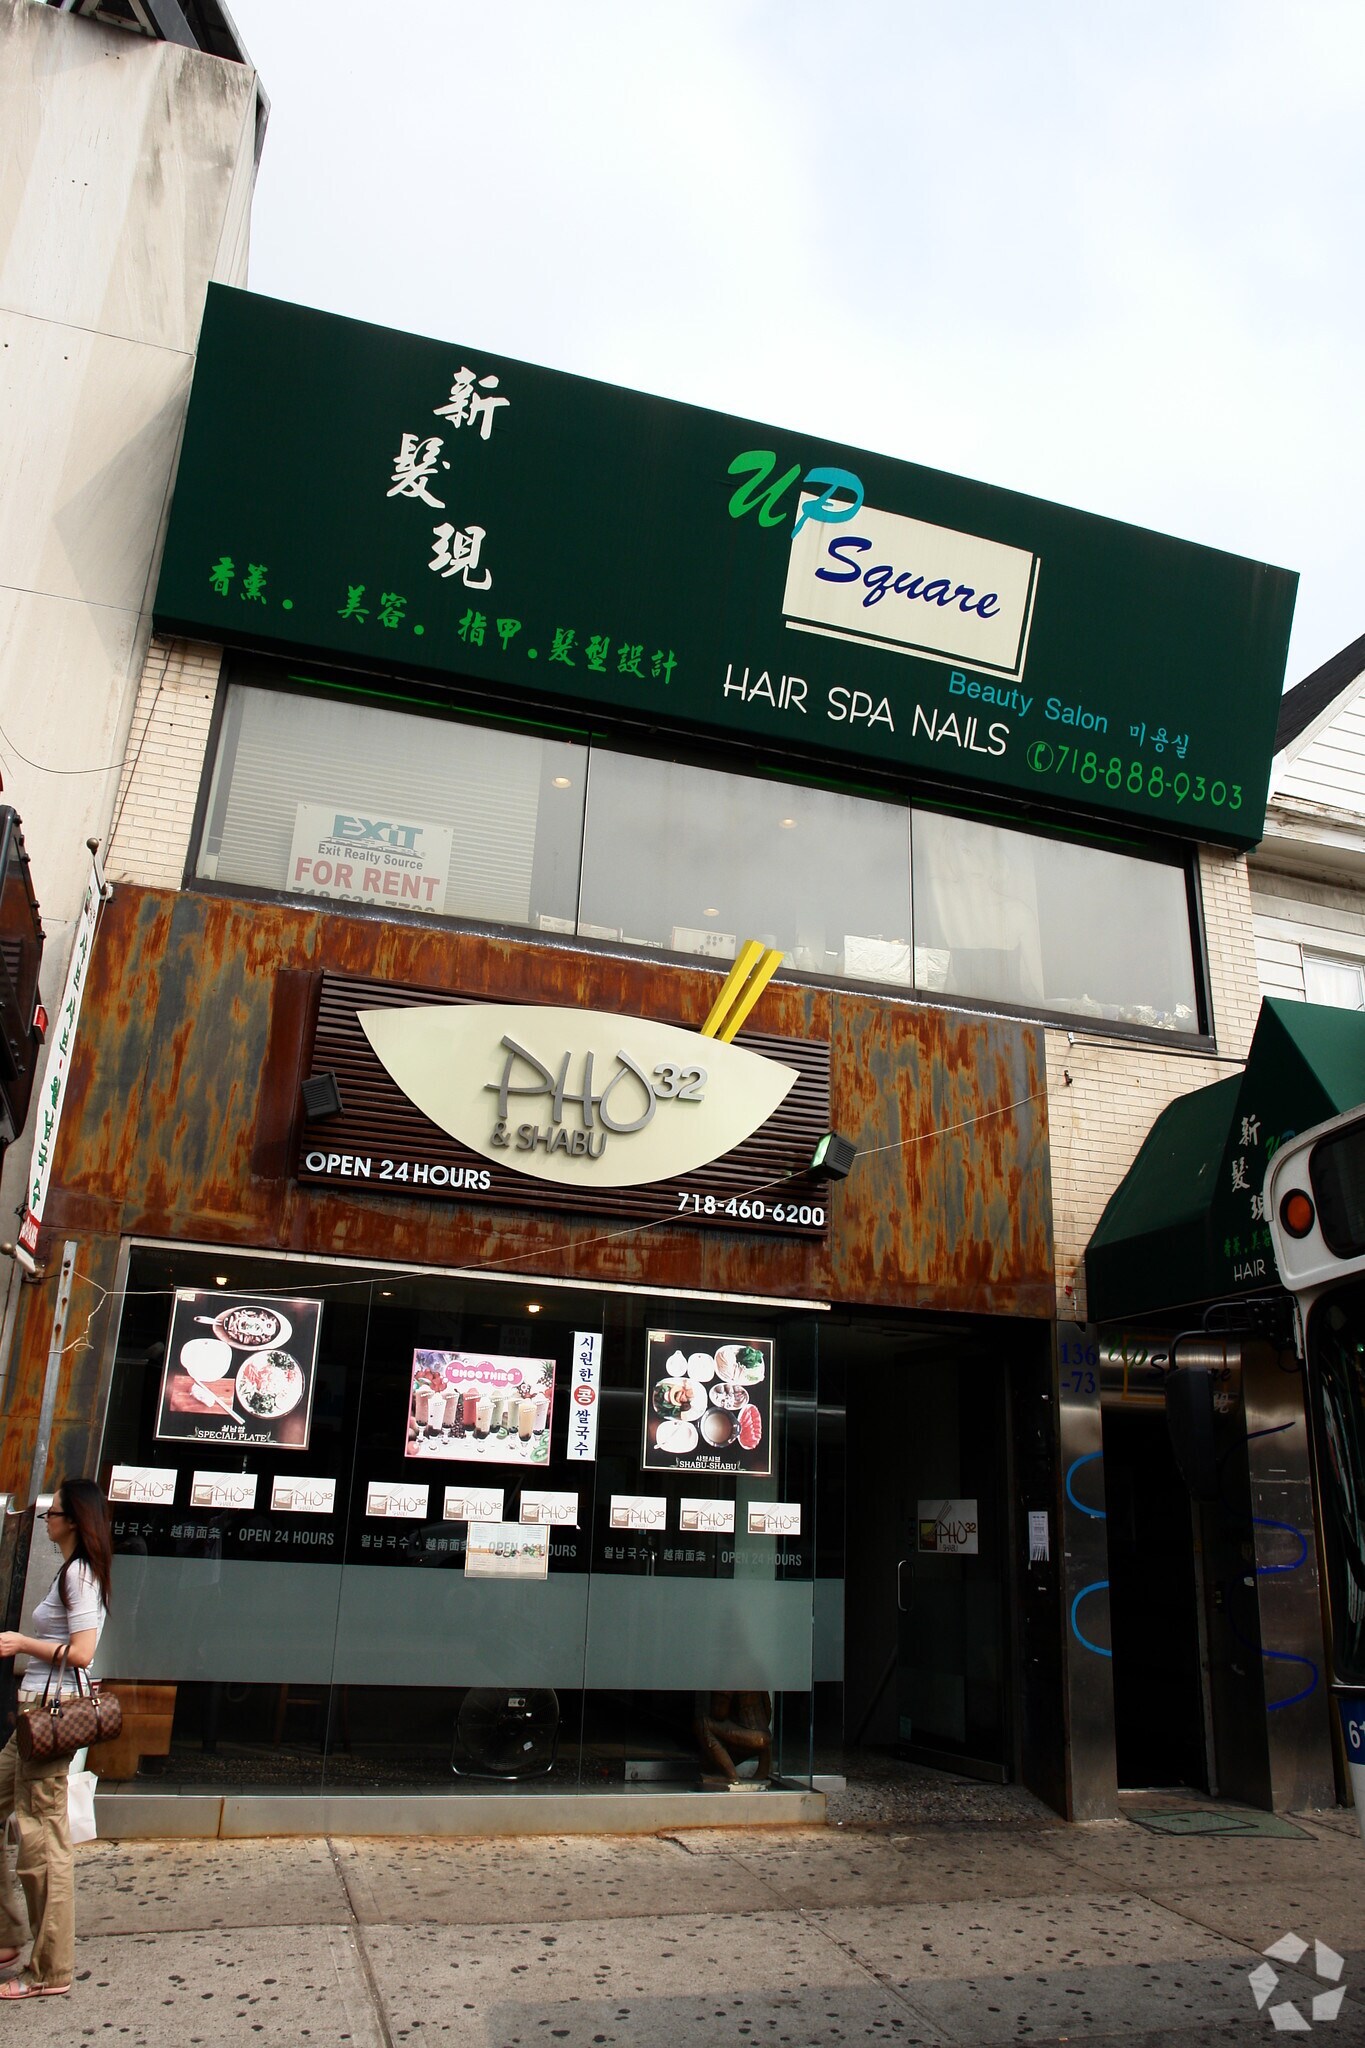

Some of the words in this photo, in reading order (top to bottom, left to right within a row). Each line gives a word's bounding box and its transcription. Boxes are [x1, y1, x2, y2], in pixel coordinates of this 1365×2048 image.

[814, 536, 1000, 620] Square
[723, 663, 808, 714] HAIR
[827, 686, 894, 732] SPA
[912, 704, 1010, 757] NAILS
[949, 671, 1033, 717] Beauty
[1045, 698, 1108, 733] Salon
[1130, 722, 1189, 759] 미용실
[1055, 744, 1242, 810] 718-888-9303
[317, 843, 340, 857] Exit
[344, 847, 381, 865] Realty
[384, 854, 424, 870] Source
[294, 856, 354, 889] FOR
[362, 867, 441, 902] RENT
[484, 1034, 657, 1132] PHO
[653, 1063, 708, 1102] 32
[488, 1119, 512, 1147] &
[518, 1123, 607, 1158] SHABU
[305, 1150, 372, 1178] OPEN
[379, 1158, 409, 1182] 24
[412, 1163, 491, 1190] HOURS
[677, 1192, 826, 1226] 718-460-6200
[1233, 1259, 1267, 1282] HAIR
[579, 1335, 594, 1382] 시원한
[1061, 1342, 1097, 1366] 136
[1061, 1370, 1096, 1394] -73
[197, 1430, 237, 1440] SPECIAL
[238, 1433, 268, 1442] PLATE
[574, 1409, 591, 1456] 쌀국수
[679, 1460, 737, 1470] SHABU-SHABU
[131, 1481, 164, 1498] PHO
[213, 1486, 245, 1502] PHO
[243, 1488, 255, 1496] 32
[293, 1490, 323, 1506] PHO
[388, 1496, 417, 1512] PHO
[464, 1500, 493, 1516] PHO
[492, 1502, 502, 1510] 32
[540, 1504, 568, 1519] PHO
[566, 1506, 577, 1514] 32
[630, 1508, 656, 1524] PHO
[655, 1510, 665, 1518] 32
[699, 1511, 725, 1527] PHO
[767, 1515, 791, 1529] PHO
[790, 1516, 800, 1524] 32
[108, 1521, 153, 1537] 남국수
[239, 1528, 270, 1542] OPEN
[274, 1530, 289, 1543] 24
[292, 1530, 334, 1546] HOURS
[361, 1534, 409, 1549] 월남국수
[936, 1520, 967, 1544] PHO
[965, 1522, 977, 1533] 32
[604, 1546, 648, 1560] 월남국수
[721, 1551, 749, 1564] OPEN
[752, 1552, 765, 1565] 24
[767, 1553, 802, 1566] HOURS
